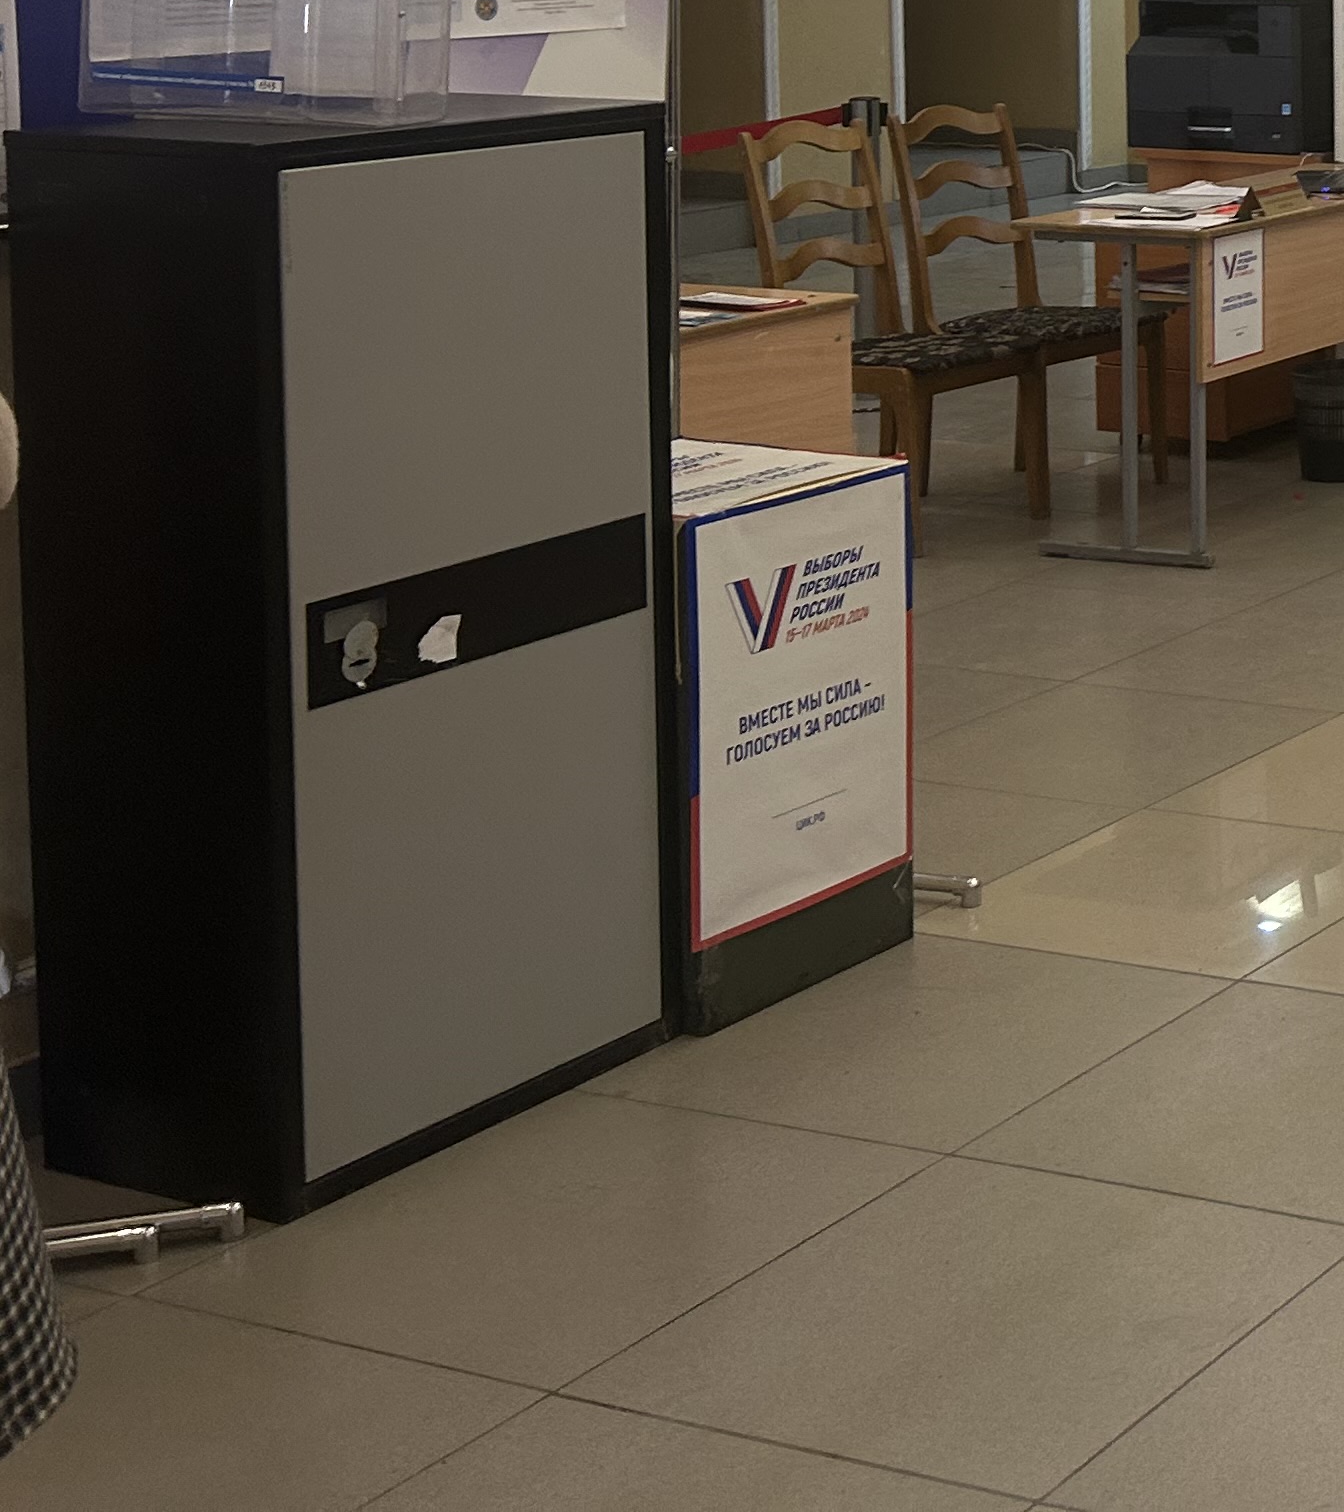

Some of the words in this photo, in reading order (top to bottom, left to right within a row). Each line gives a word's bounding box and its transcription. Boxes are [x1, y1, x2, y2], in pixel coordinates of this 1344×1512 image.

[802, 545, 865, 577] ВЫБОРЫ
[795, 561, 881, 601] ПРЕЗИДЕНТА
[789, 593, 846, 624] РОССИИ
[812, 612, 846, 636] МАРТА
[738, 699, 794, 735] ВМЕСТЕ
[797, 690, 822, 716] МЫ
[825, 678, 862, 706] СИЛА
[726, 723, 801, 766] ГОЛОСУЕМ
[804, 717, 822, 738] ЗА
[824, 693, 886, 731] РОССИЮ!
